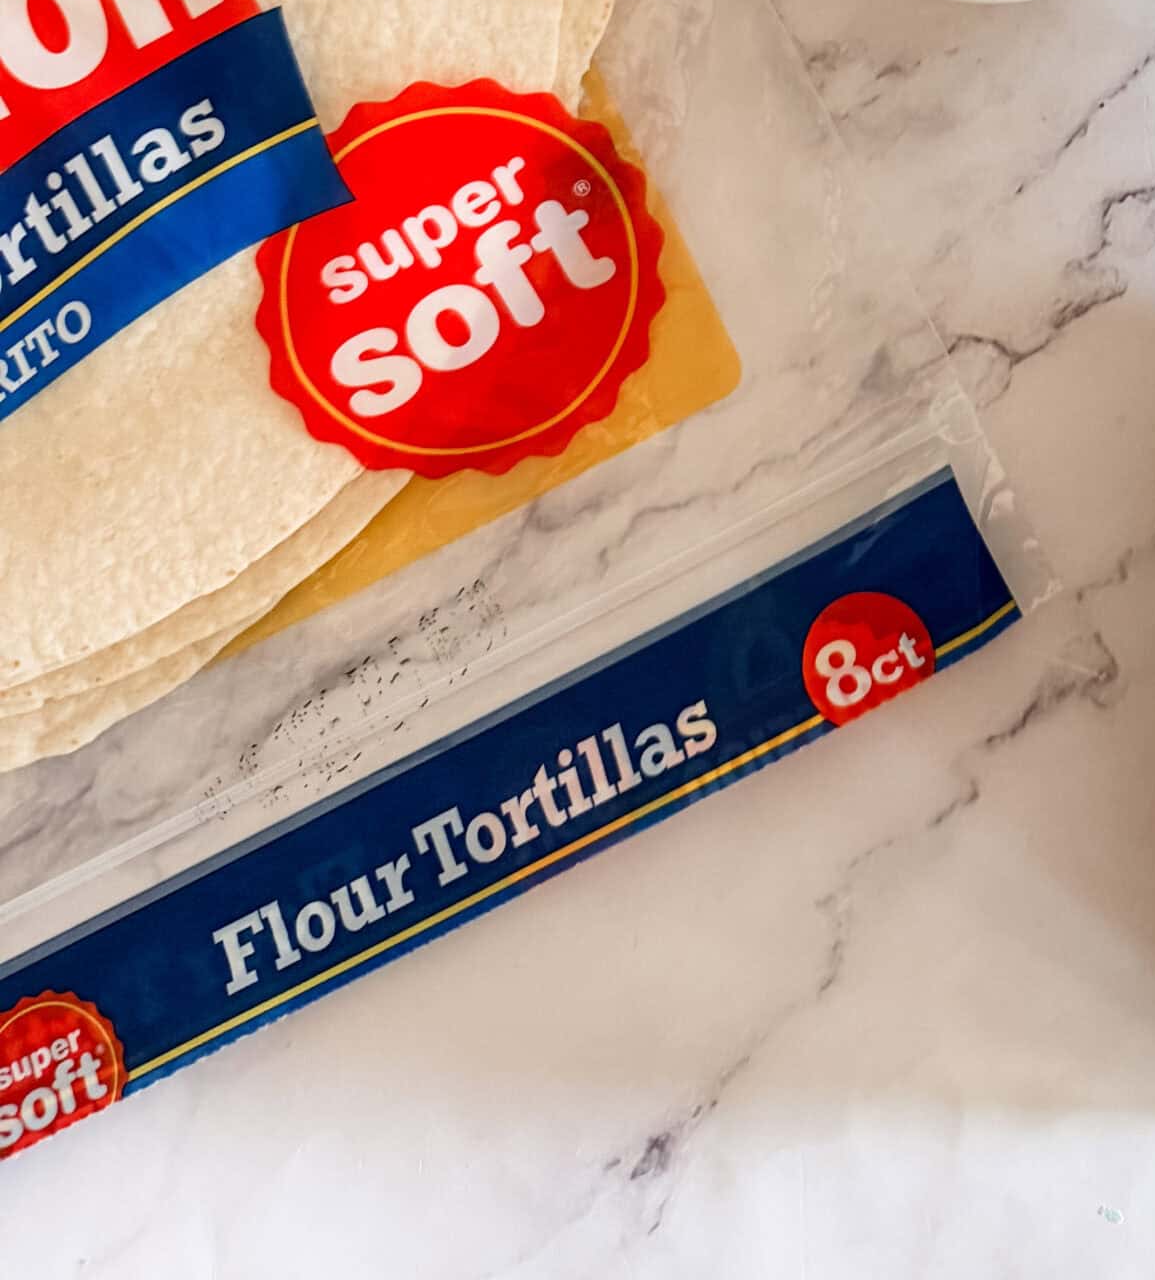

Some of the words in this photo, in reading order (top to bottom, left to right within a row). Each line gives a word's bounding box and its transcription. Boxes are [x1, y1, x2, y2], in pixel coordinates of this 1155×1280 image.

[0, 98, 226, 297] rtillas
[320, 156, 525, 305] super
[329, 199, 617, 418] soft
[815, 631, 926, 708] 8ct
[212, 852, 414, 996] Flour
[411, 699, 718, 887] Tortillas
[0, 1028, 81, 1091] super
[0, 1051, 108, 1148] soft
